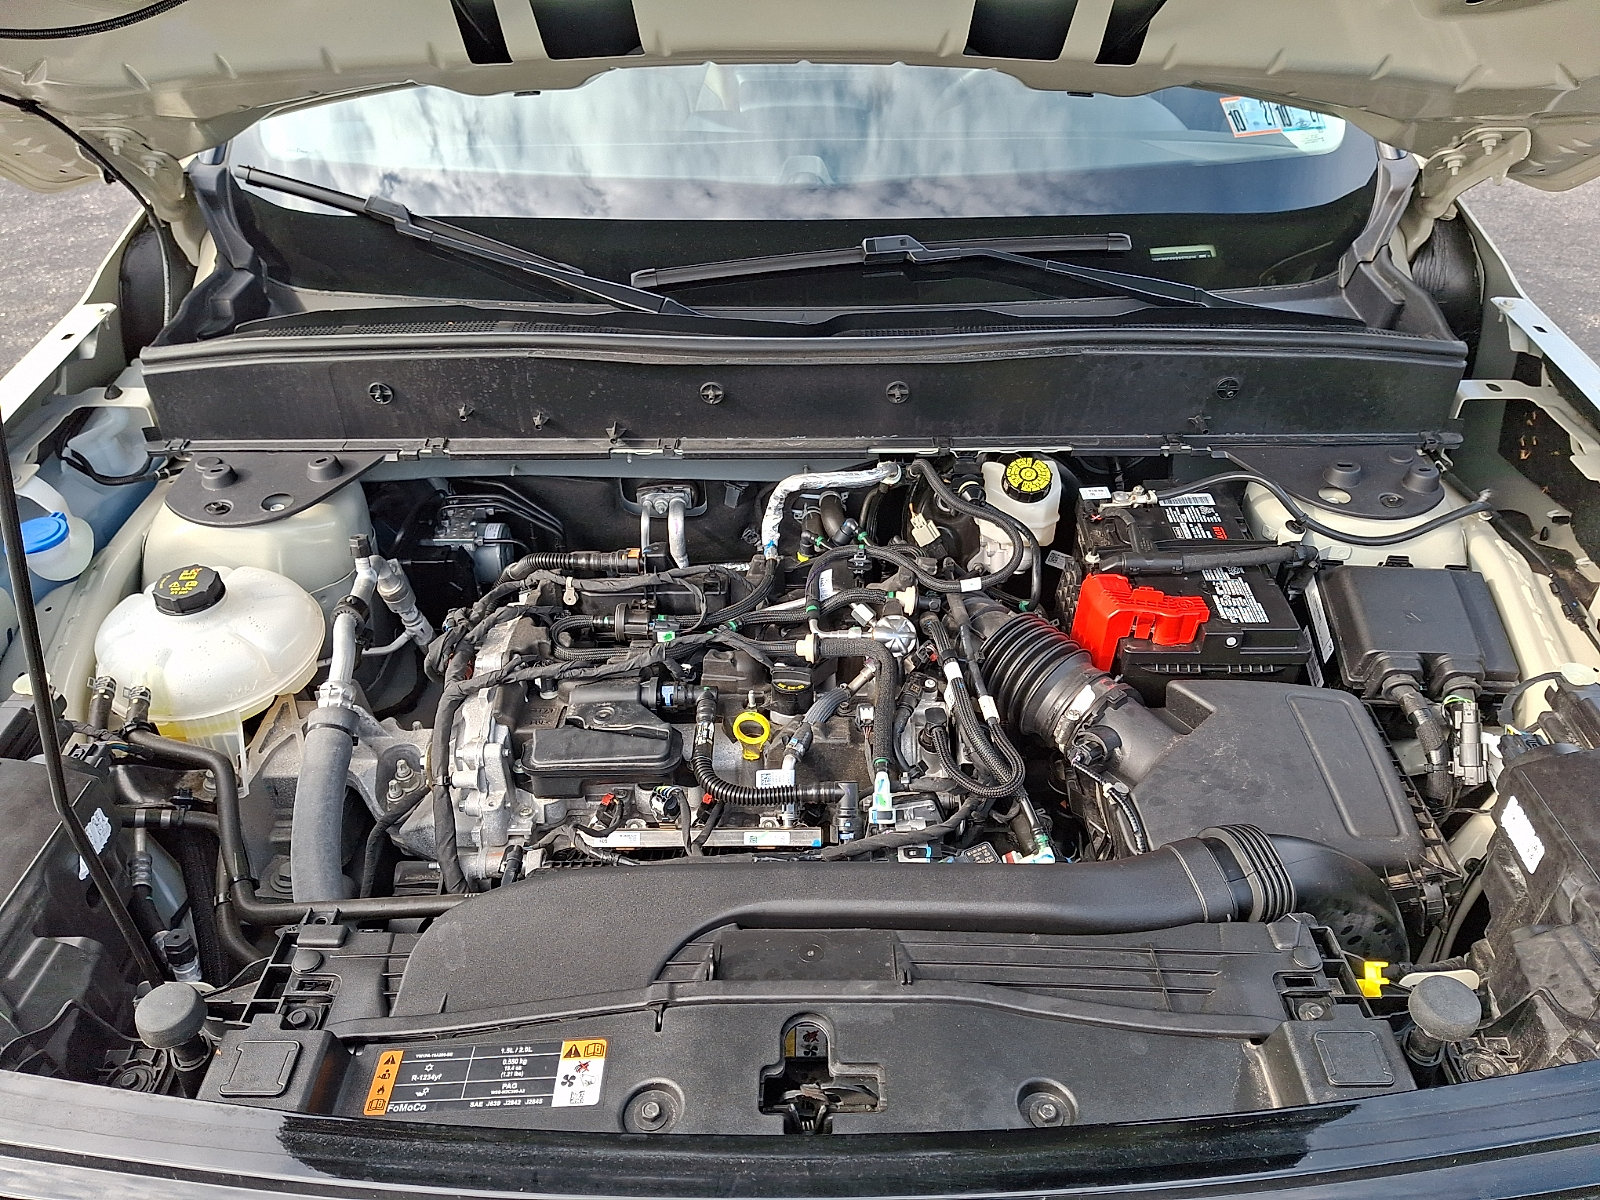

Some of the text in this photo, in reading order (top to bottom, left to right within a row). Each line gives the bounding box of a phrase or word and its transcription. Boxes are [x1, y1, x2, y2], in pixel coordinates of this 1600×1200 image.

[1228, 109, 1247, 132] 10
[411, 1073, 442, 1081] R-1234yf
[387, 1103, 427, 1112] FoMoCo
